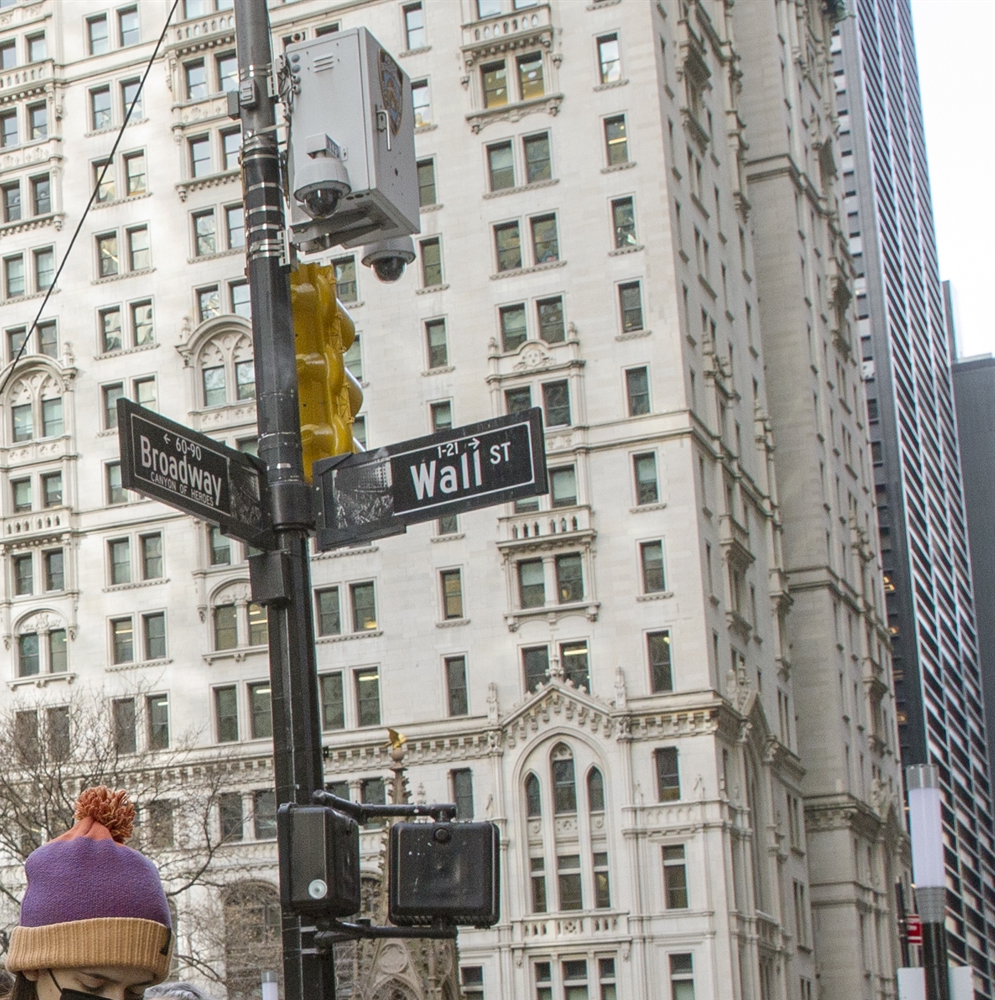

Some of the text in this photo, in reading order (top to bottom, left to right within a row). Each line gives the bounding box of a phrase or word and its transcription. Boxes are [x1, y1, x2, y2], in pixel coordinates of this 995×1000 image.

[175, 437, 202, 462] 60-90
[436, 441, 459, 459] 1-21
[139, 434, 222, 507] Broadway
[409, 441, 511, 501] Wall ST
[150, 471, 215, 507] CANYON OF HEROES
